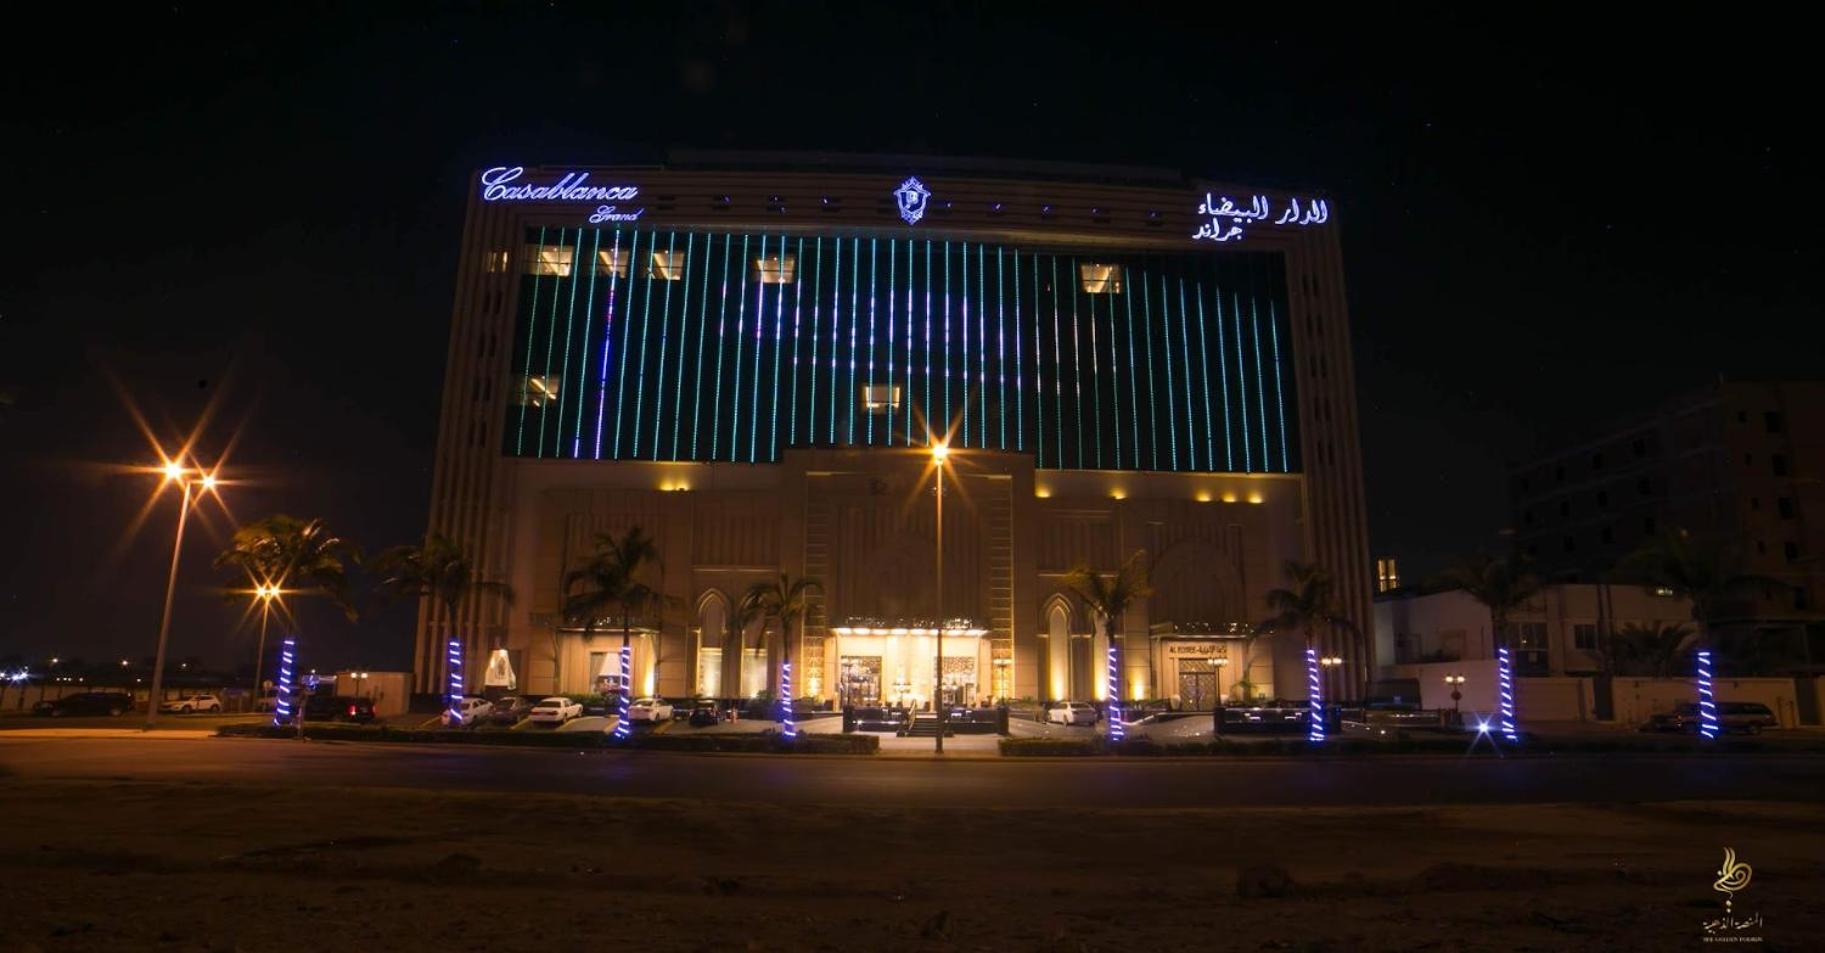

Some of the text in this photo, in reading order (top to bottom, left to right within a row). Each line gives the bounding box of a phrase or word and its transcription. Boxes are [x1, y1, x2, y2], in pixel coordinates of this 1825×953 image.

[481, 166, 639, 201] Casablanca
[588, 205, 645, 224] Grand
[1198, 192, 1329, 225] الدار البيضاء
[1192, 217, 1243, 242] جراند
